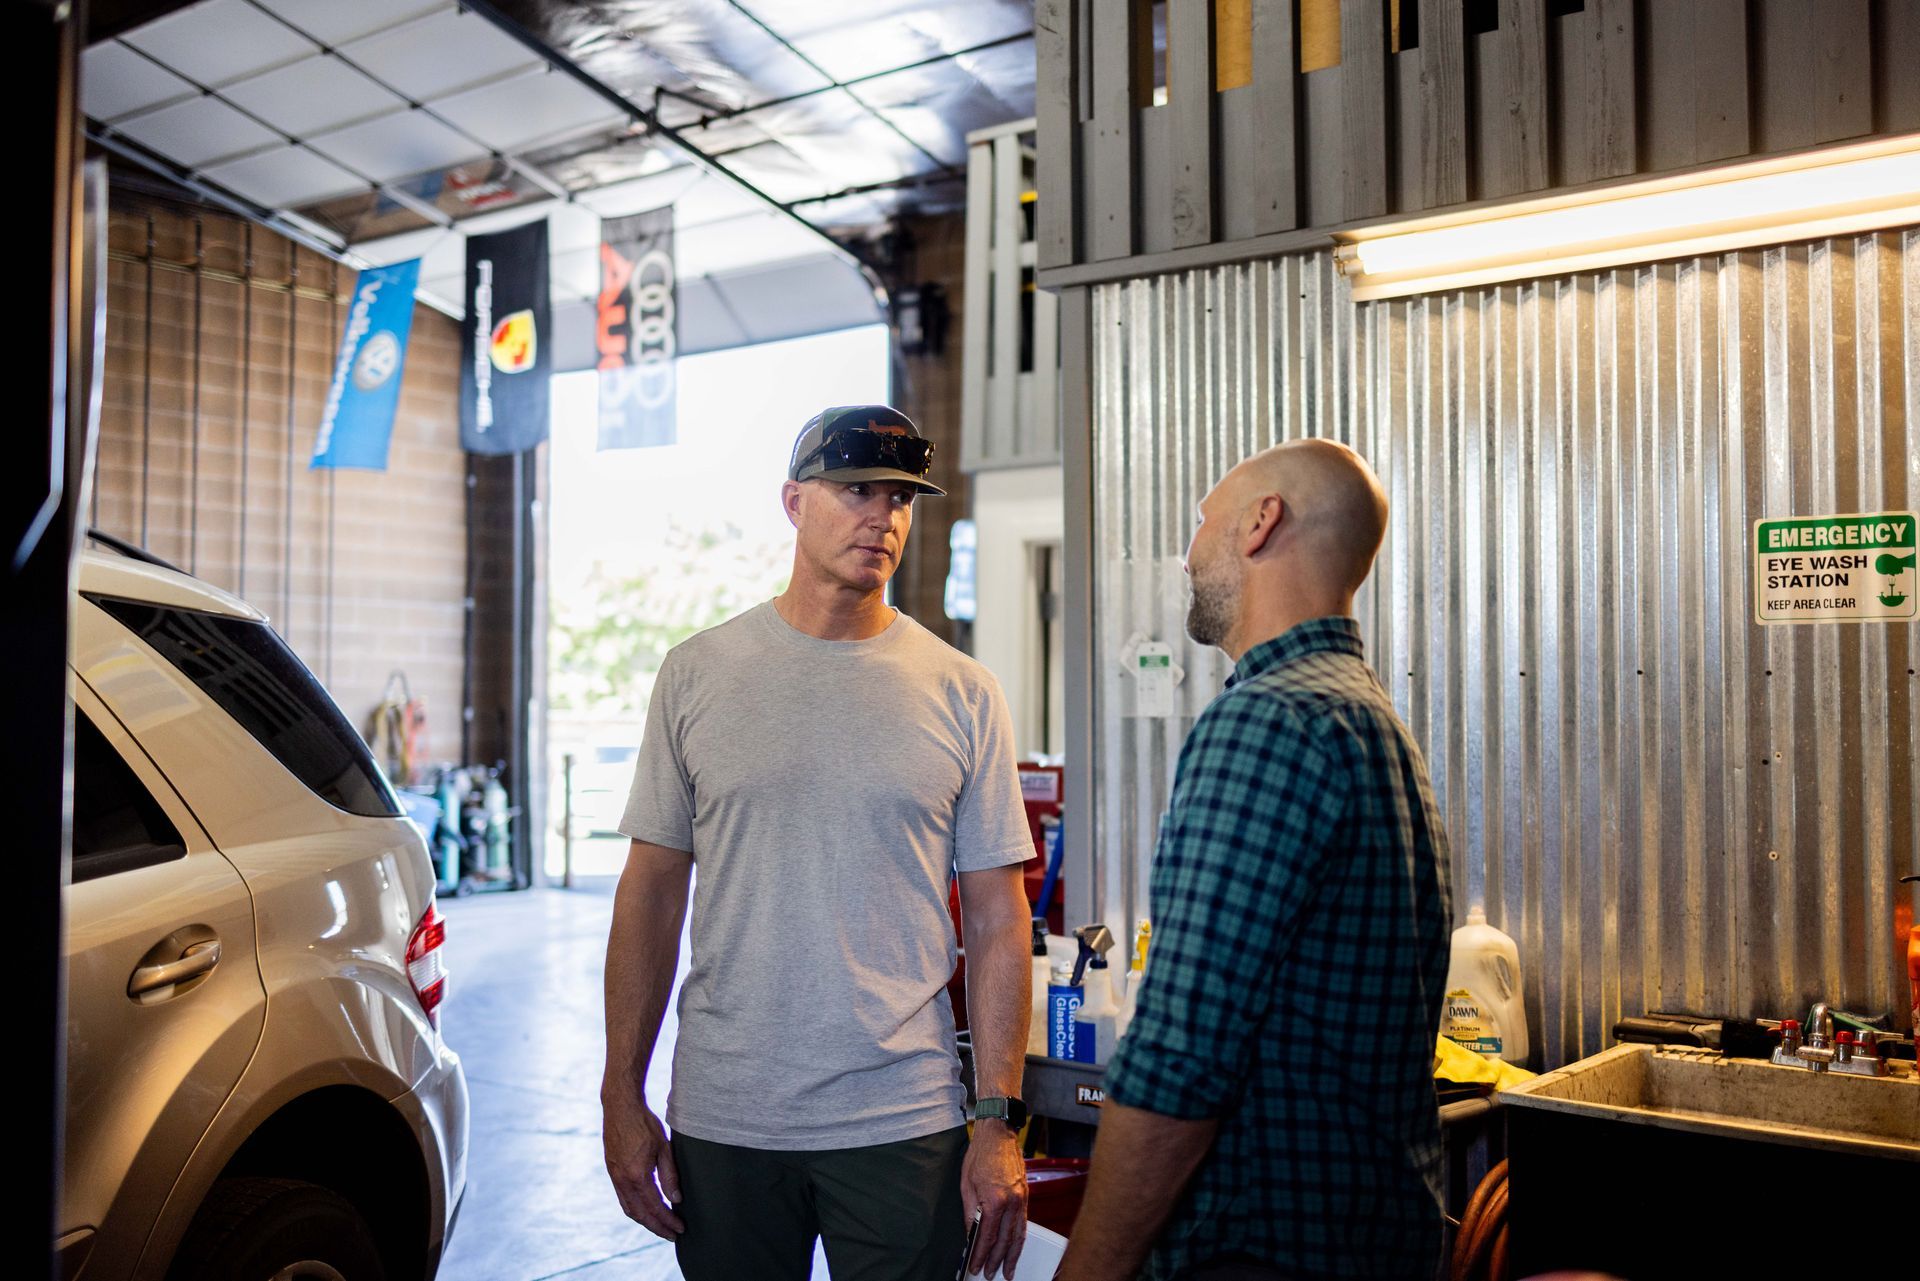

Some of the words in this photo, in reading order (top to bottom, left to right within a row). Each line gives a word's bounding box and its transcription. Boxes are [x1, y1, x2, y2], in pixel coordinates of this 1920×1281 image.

[1768, 523, 1907, 548] EMERGENCY
[1767, 557, 1803, 571] EYE
[1810, 555, 1867, 570] WASH
[1767, 573, 1849, 589] STATION
[1767, 600, 1791, 610] KEEP
[1793, 599, 1821, 609] AREA
[1823, 598, 1856, 609] CLEAR
[1449, 1006, 1478, 1018] DAWN
[1056, 997, 1066, 1060] GlassClea
[1457, 1041, 1480, 1051] STER
